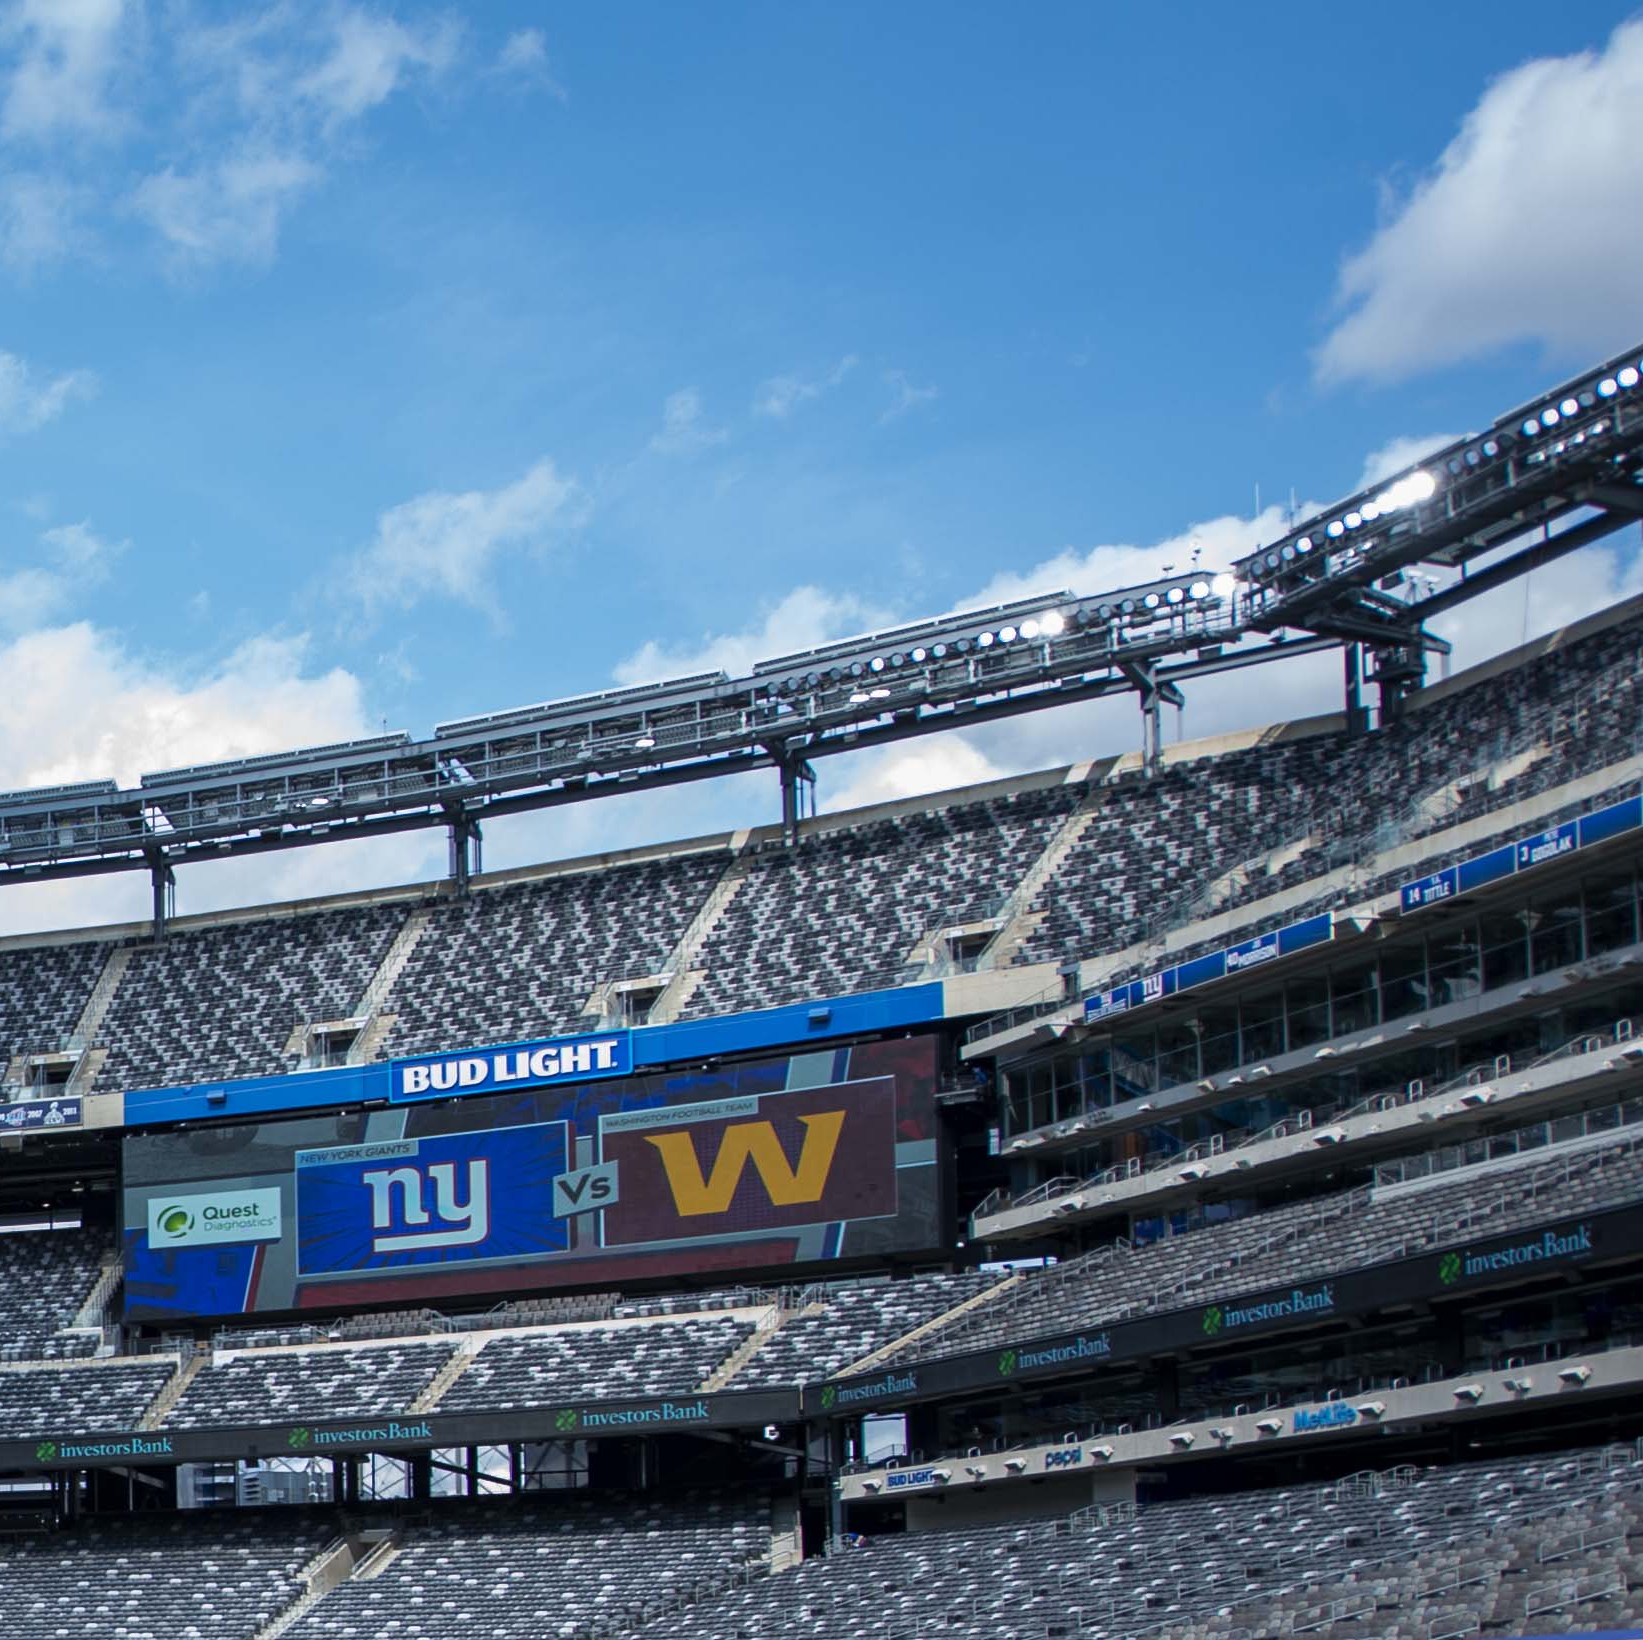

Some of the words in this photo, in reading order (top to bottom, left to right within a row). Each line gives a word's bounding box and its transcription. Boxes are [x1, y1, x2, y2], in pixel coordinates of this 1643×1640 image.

[1143, 974, 1163, 1002] ny
[402, 1060, 488, 1095] BUD
[493, 1040, 619, 1086] LIGHT
[301, 1152, 329, 1163] NEW
[332, 1149, 363, 1160] YORK
[365, 1144, 411, 1157] GIANTS
[643, 1110, 847, 1216] W
[202, 1202, 260, 1222] Quest
[363, 1159, 487, 1252] ny
[203, 1214, 277, 1232] Diagnostics
[1465, 1225, 1592, 1277] investorsBank
[1224, 1290, 1334, 1328] investorsBank
[1018, 1332, 1111, 1369] investorsBank
[838, 1374, 916, 1402] investorsBank
[582, 1402, 708, 1428] investorsBank
[1294, 1403, 1356, 1432] MetLife
[60, 1437, 173, 1457] investorsBank
[314, 1421, 431, 1445] investorsBank
[1045, 1446, 1081, 1469] pepsi
